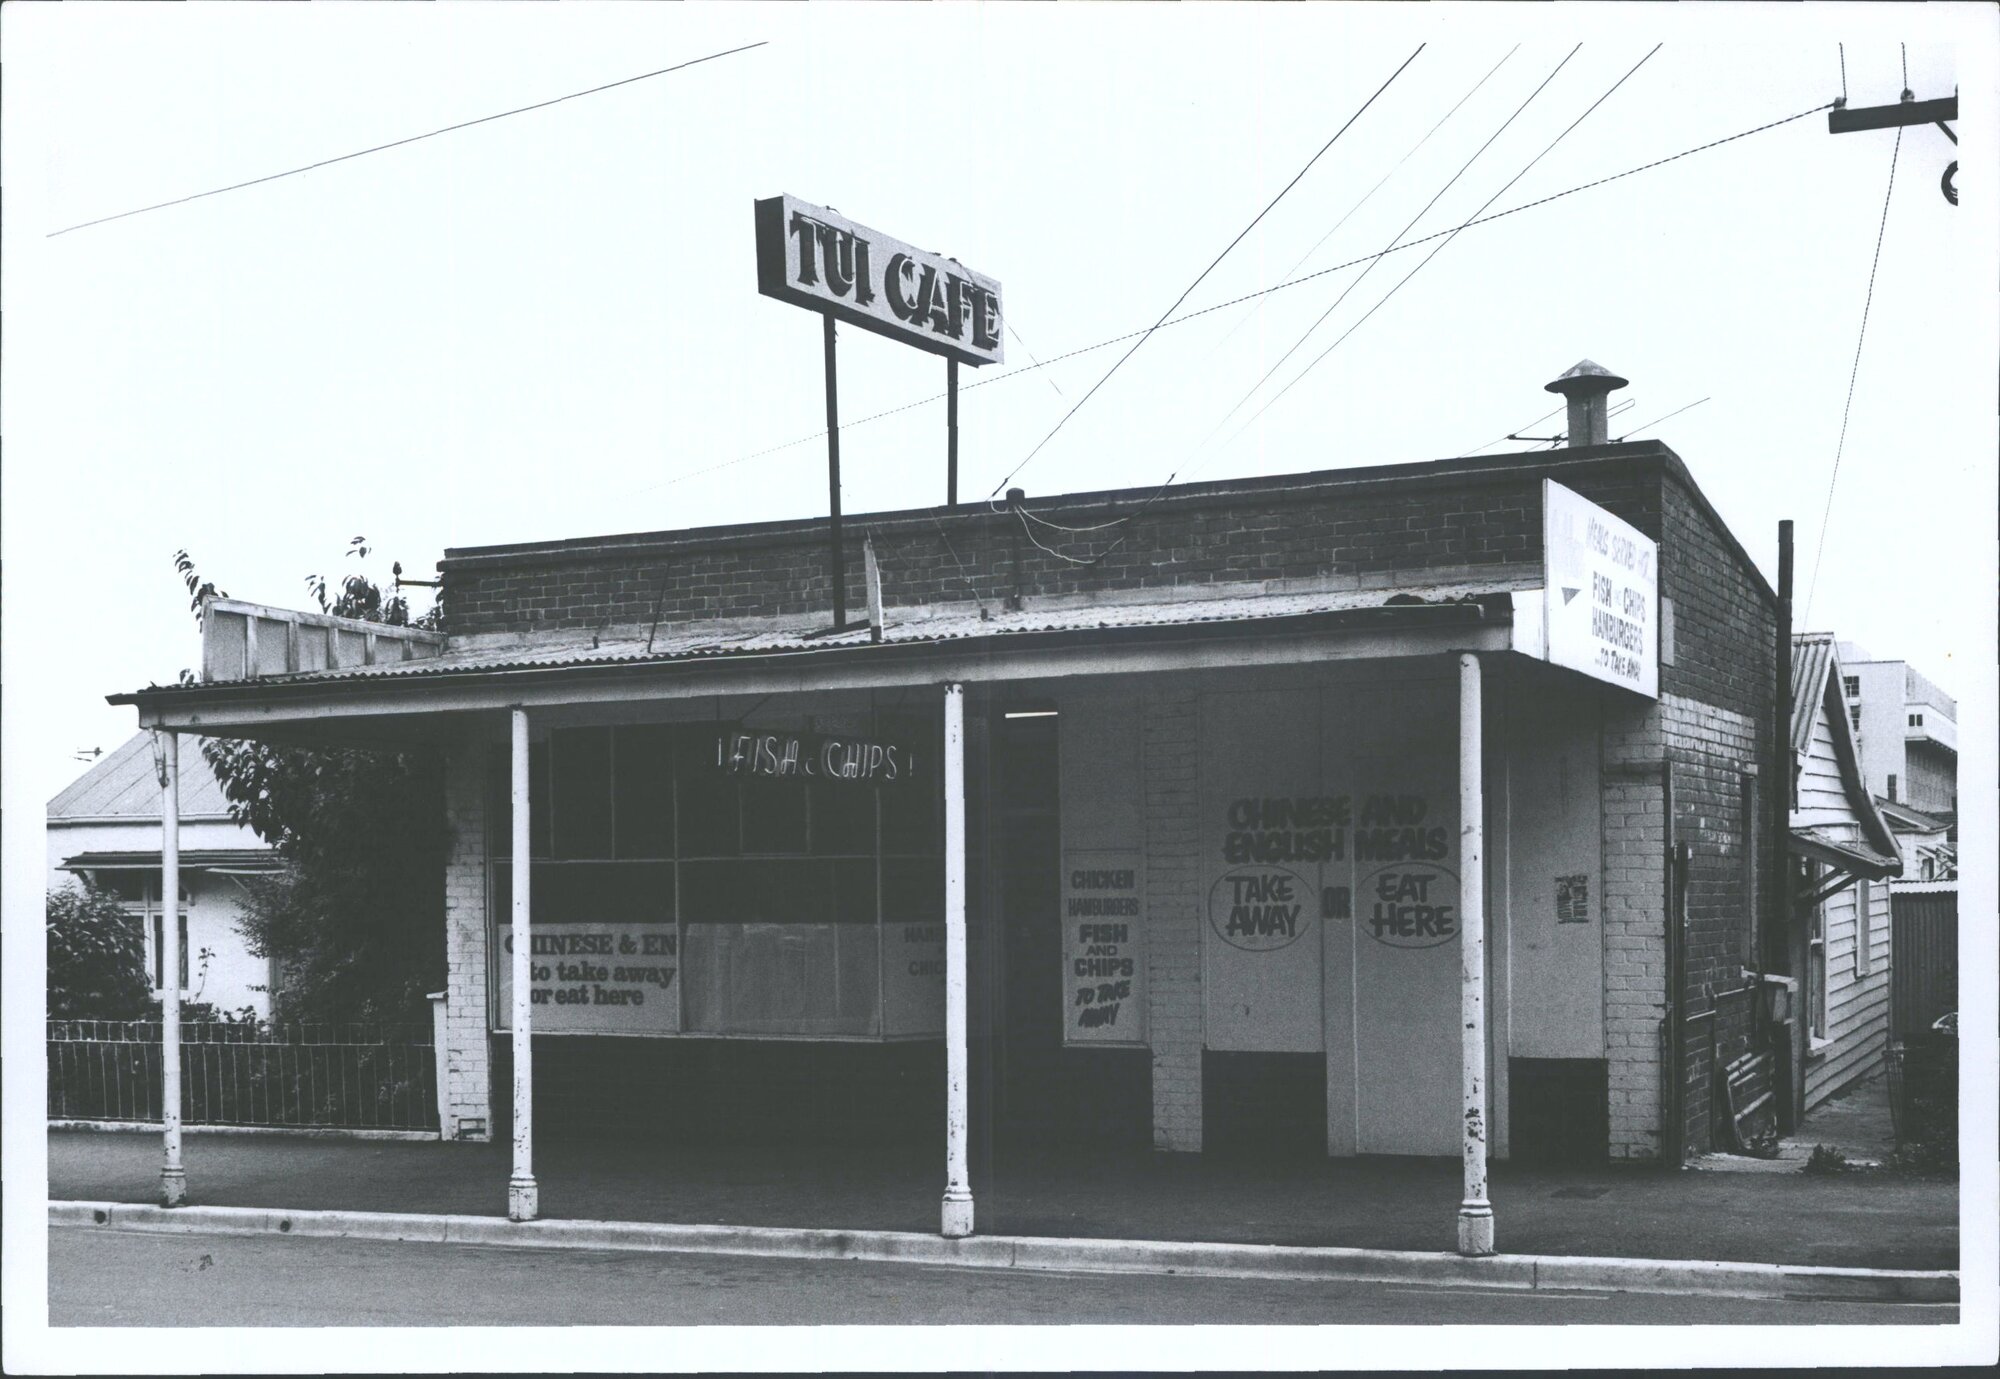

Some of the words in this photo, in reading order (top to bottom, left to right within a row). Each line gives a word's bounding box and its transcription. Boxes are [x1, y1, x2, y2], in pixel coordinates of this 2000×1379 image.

[789, 210, 876, 308] TUI
[884, 252, 1002, 352] CAFE
[1592, 570, 1613, 609] FISH
[1623, 587, 1646, 624] CHIPS
[1591, 605, 1643, 656] HAMBURGERS
[1611, 650, 1626, 676] TAKE
[732, 735, 799, 775] FISH
[827, 741, 897, 780] CHIPS
[1226, 796, 1352, 831] CHINESE
[1360, 794, 1428, 827] AND
[1222, 829, 1345, 864] ENGLISH
[1353, 826, 1449, 862] MEALS
[1071, 869, 1135, 890] CHICKEN
[1224, 874, 1295, 905] TAKE
[1375, 873, 1438, 903] EAT
[1067, 897, 1140, 917] HAMBURGERS
[1322, 886, 1351, 919] OR
[1079, 923, 1129, 944] FISH
[1225, 904, 1302, 938] AWAY
[1368, 902, 1455, 938] HERE
[619, 933, 638, 956] &
[1085, 945, 1118, 956] AND
[531, 961, 551, 982] to
[556, 960, 609, 982] take
[613, 966, 677, 990] away
[1074, 957, 1134, 977] CHIPS
[531, 987, 553, 1006] or
[554, 984, 590, 1006] eat
[593, 984, 645, 1006] here
[1075, 987, 1095, 1006] TO
[1097, 979, 1132, 1004] TAKE
